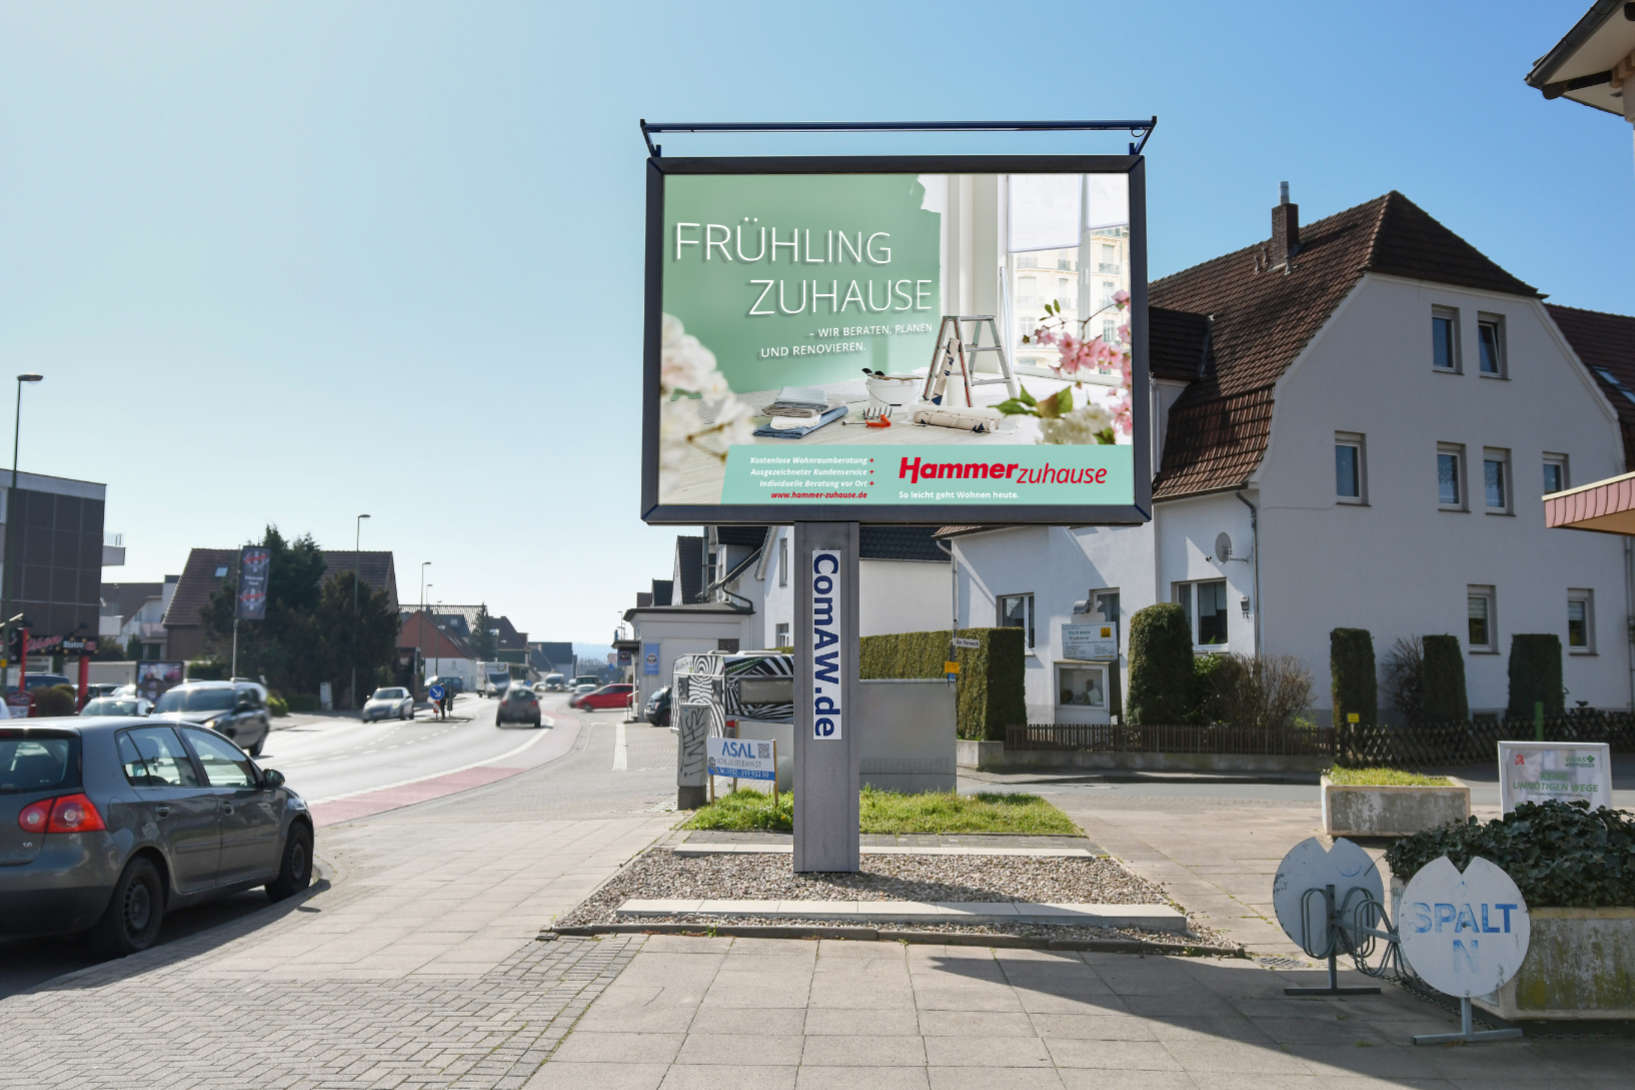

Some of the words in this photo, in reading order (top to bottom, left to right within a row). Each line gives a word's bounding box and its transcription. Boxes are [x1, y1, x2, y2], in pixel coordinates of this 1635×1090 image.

[675, 216, 892, 264] FRÜHLING
[749, 279, 932, 315] ZUHAUSE
[818, 327, 841, 338] WIR
[843, 325, 892, 337] BERATEN,
[894, 322, 933, 335] PLANEN
[760, 346, 789, 358] UND
[792, 341, 867, 356] RENOVIEREN.
[750, 456, 791, 464] Kostenlose
[792, 456, 868, 466] Wohnraumberatung
[750, 468, 812, 477] Ausgezeichneter
[813, 468, 867, 476] Kundenservice
[760, 480, 803, 488] Individuelle
[804, 480, 839, 488] Beratung
[854, 480, 867, 488] Ort
[770, 491, 868, 499] www.hammer-zuhause.de
[898, 490, 909, 499] So
[910, 490, 934, 499] leicht
[935, 490, 955, 501] geht
[956, 490, 990, 499] Wohnen
[992, 490, 1019, 499] heute.
[813, 553, 841, 736] ComAW.de
